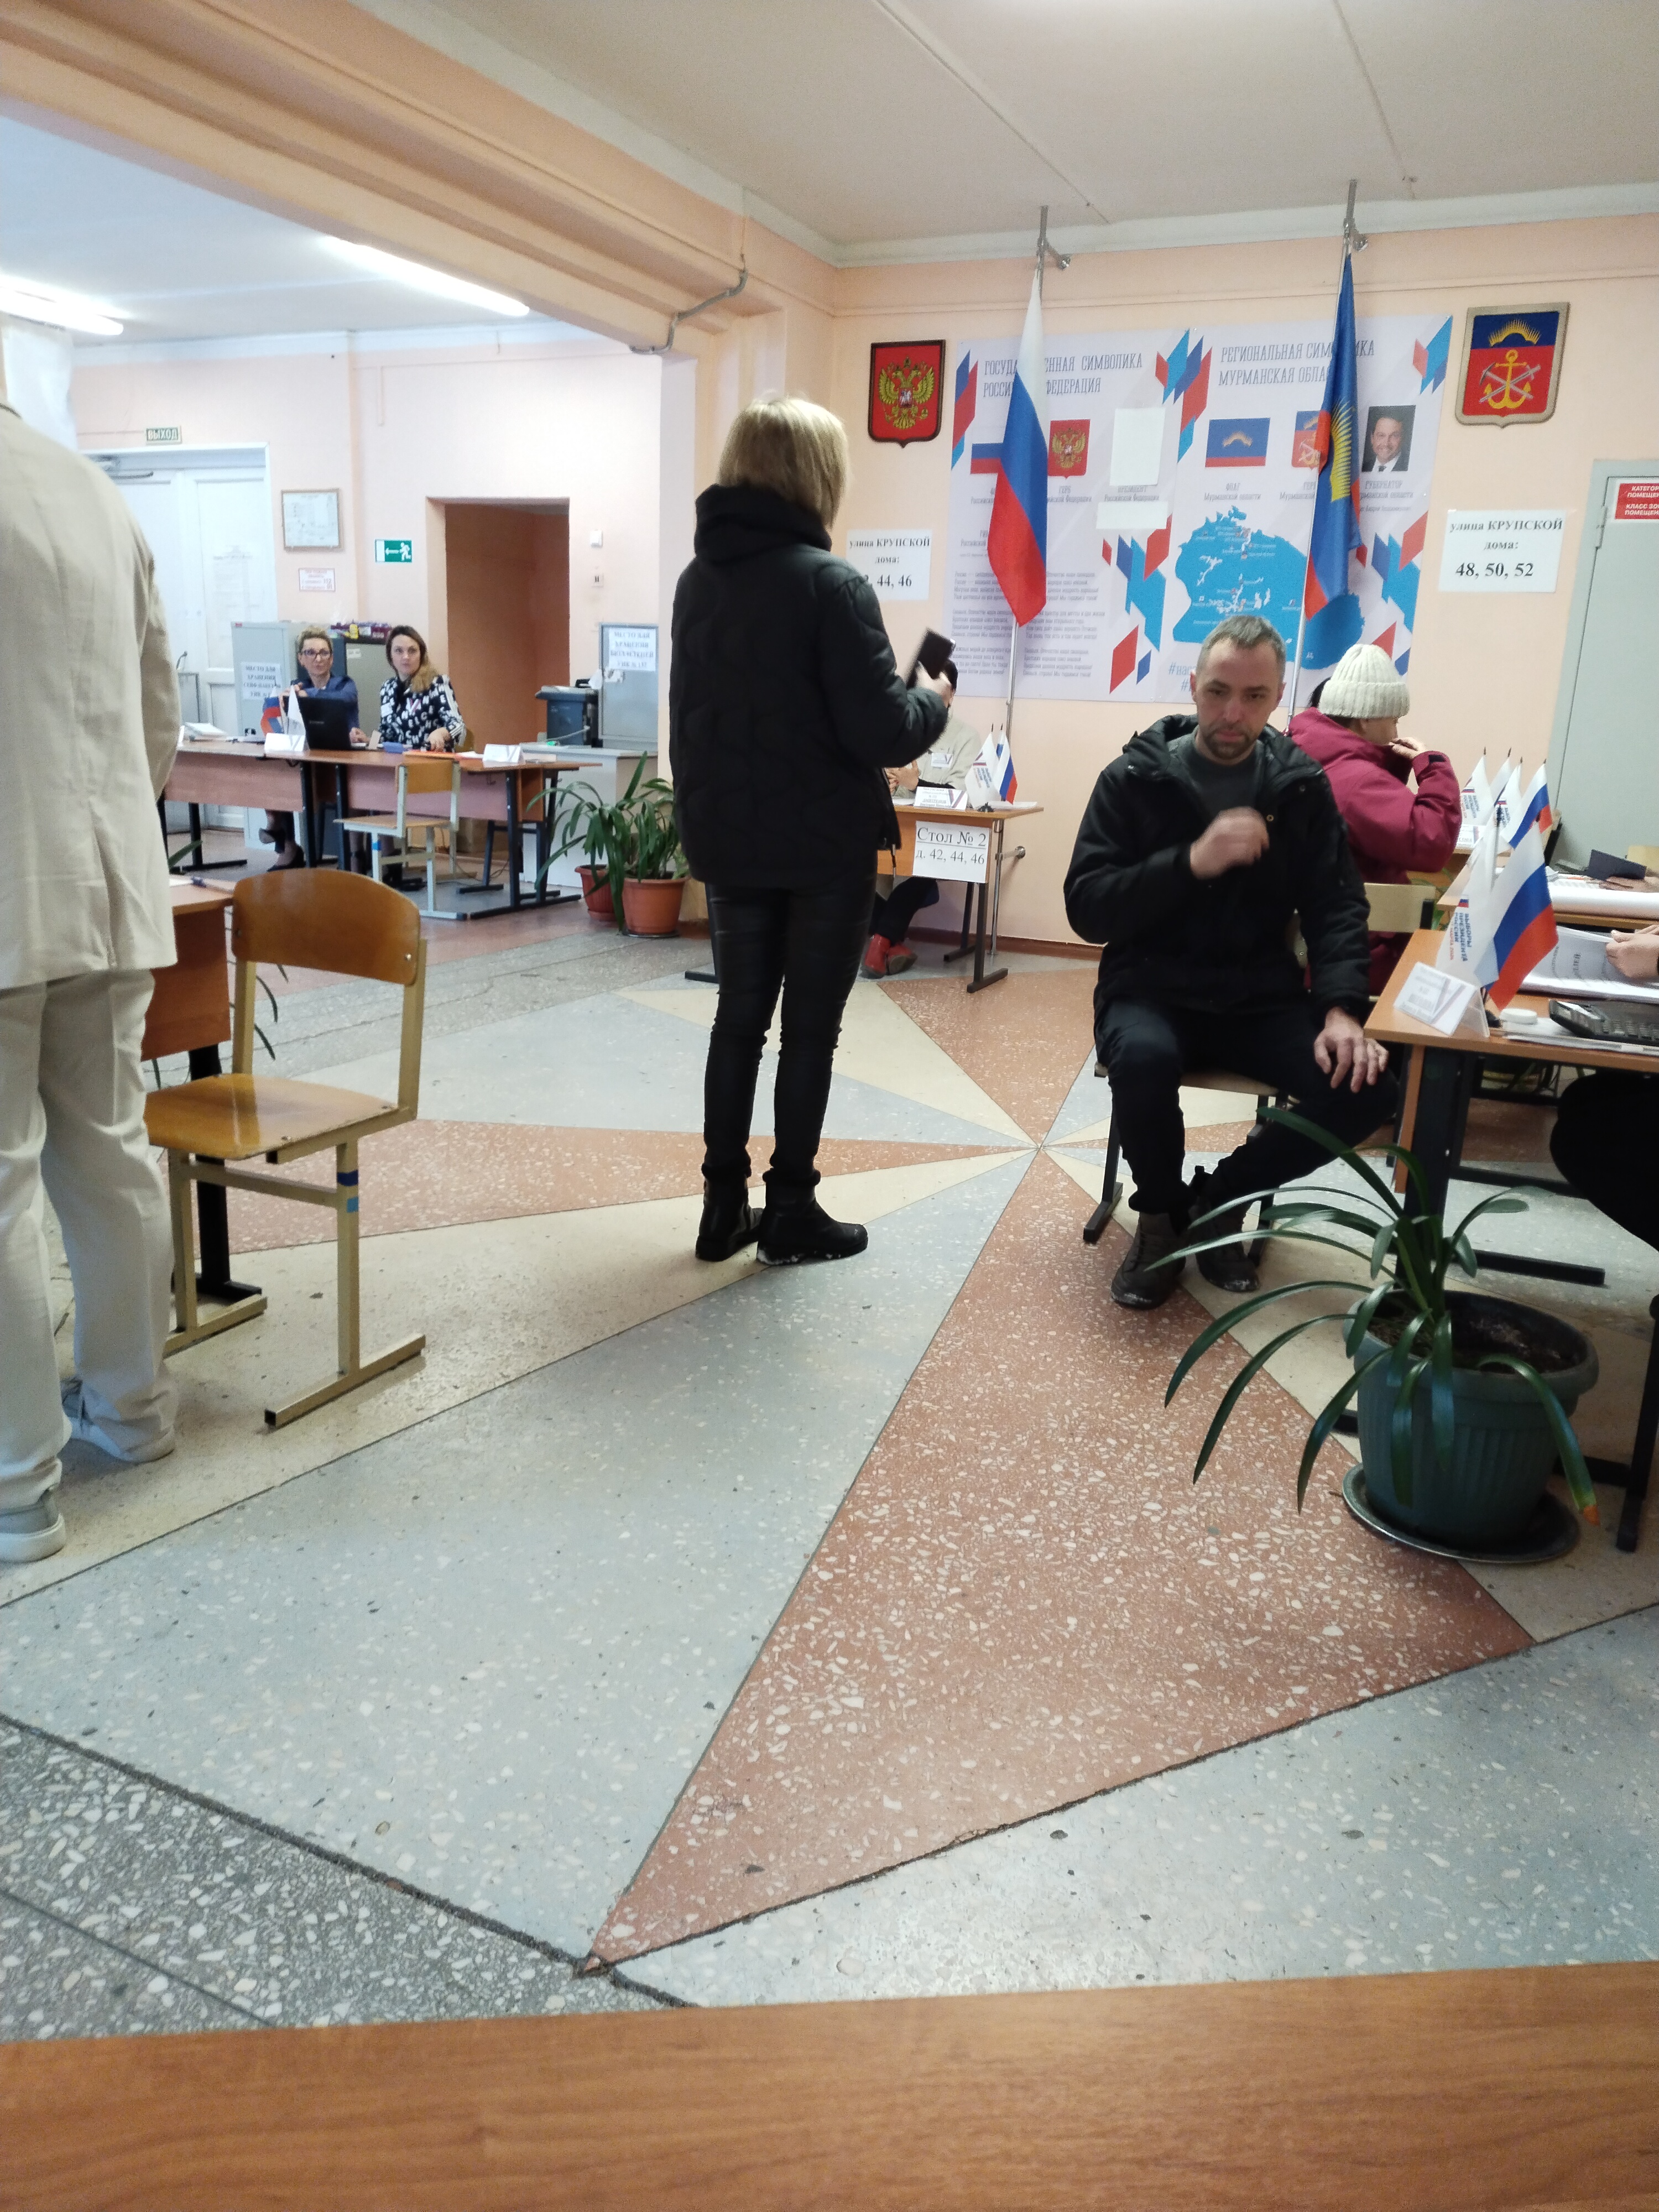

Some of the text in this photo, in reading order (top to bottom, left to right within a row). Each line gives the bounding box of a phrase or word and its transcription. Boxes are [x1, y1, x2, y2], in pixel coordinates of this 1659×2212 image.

[1220, 343, 1303, 362] РЕГИОНАЛЬНАЯ
[1081, 353, 1142, 371] СИМВОЛИКА
[1218, 366, 1326, 385] МУРМАНСКАЯ ОБЛА
[148, 429, 178, 440] ВЫХОД
[1450, 518, 1563, 533] улица КРУПСКОЙ
[850, 536, 930, 549] улица КРУПСКОЙ
[1483, 542, 1519, 550] дома:
[1455, 562, 1534, 579] 48, 50, 52
[877, 575, 894, 589] 44,
[898, 575, 912, 587] 46
[917, 827, 986, 846] Стол № 2
[916, 849, 984, 864] д. 42, 44, 46
